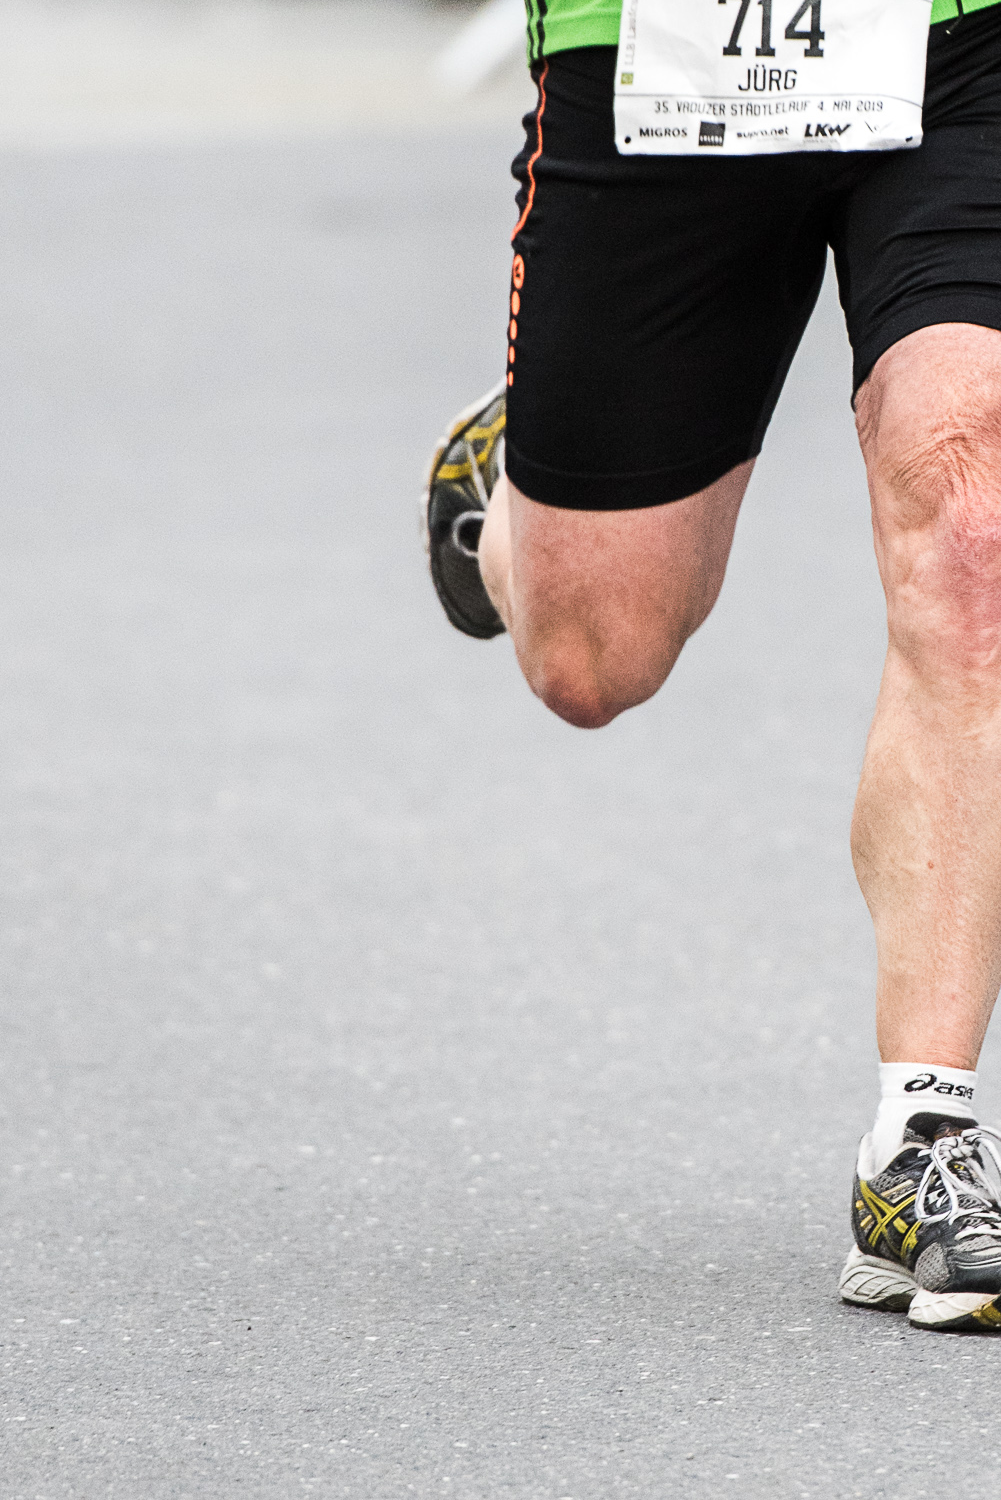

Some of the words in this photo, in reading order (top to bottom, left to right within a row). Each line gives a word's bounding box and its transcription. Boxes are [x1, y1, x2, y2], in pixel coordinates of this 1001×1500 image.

[738, 64, 797, 91] JÜRG
[856, 100, 883, 112] 2019
[639, 127, 688, 138] MIGROS
[804, 123, 852, 138] LKW
